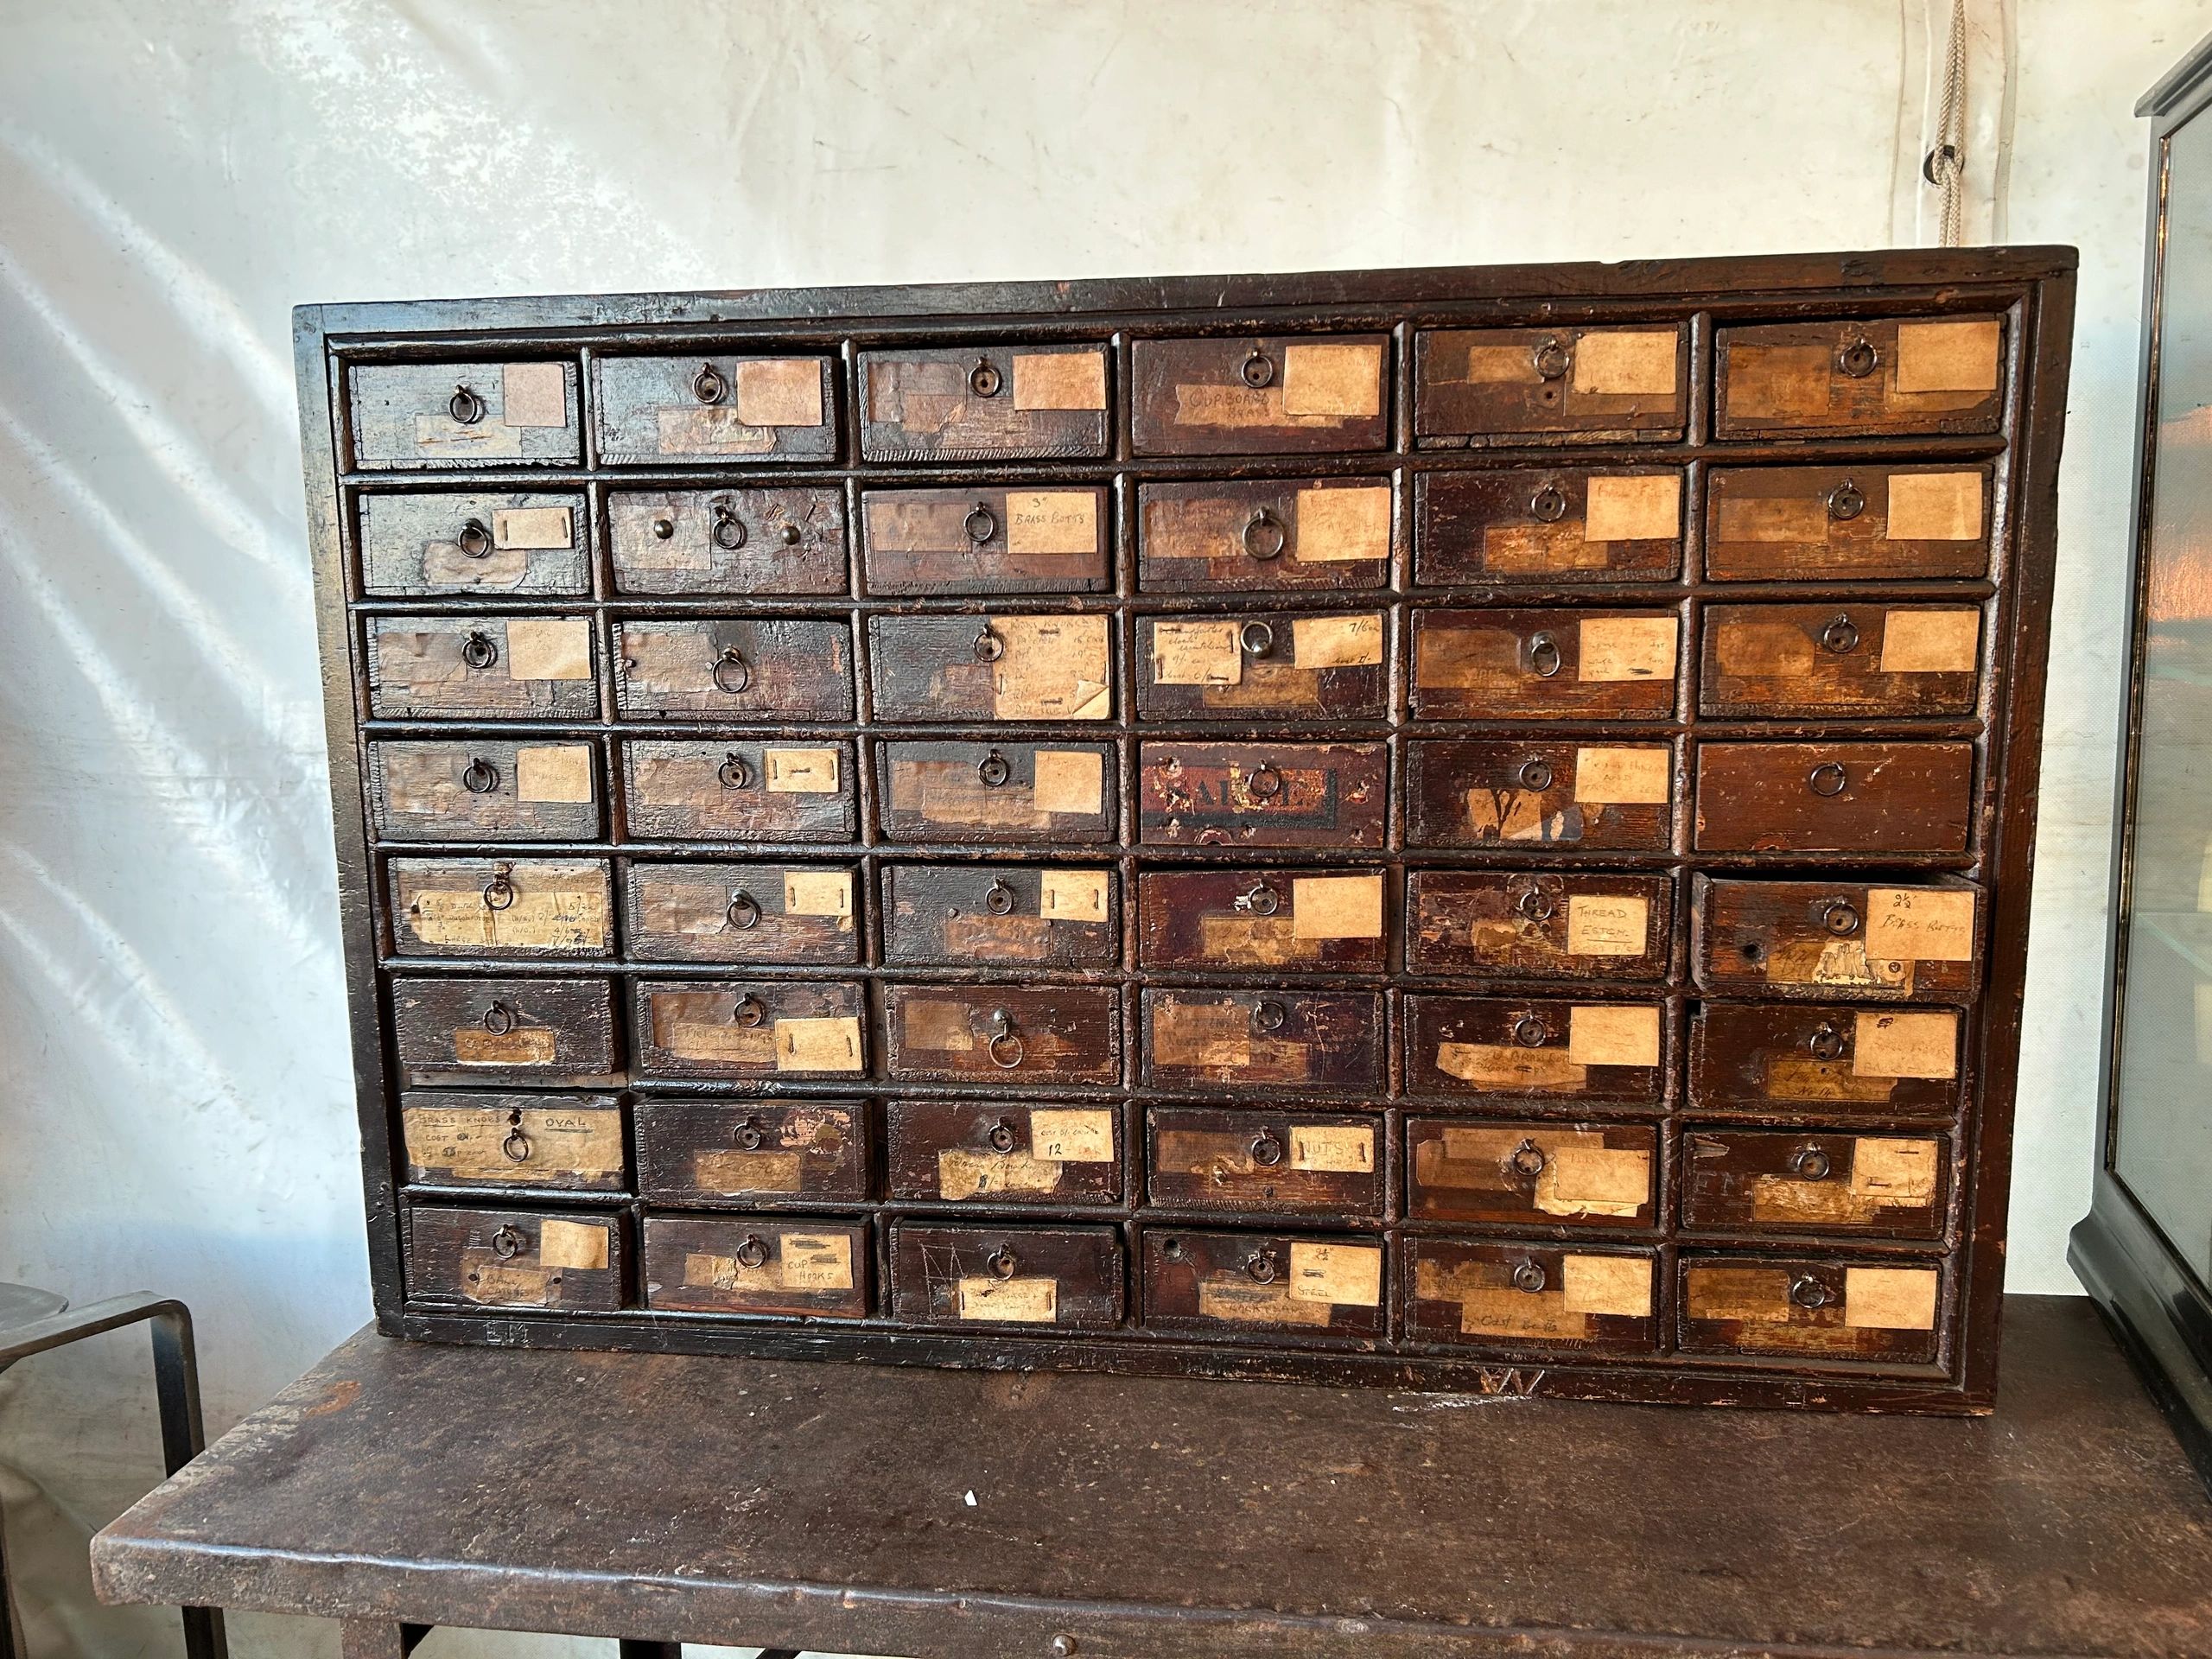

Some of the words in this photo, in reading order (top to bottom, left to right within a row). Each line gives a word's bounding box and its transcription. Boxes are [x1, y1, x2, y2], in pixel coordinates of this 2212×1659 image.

[1014, 512, 1046, 525] BRASS
[1577, 905, 1627, 918] THREAD
[545, 1116, 588, 1128] OVAL
[787, 1259, 809, 1270] CUP
[798, 1271, 835, 1281] HOOKS
